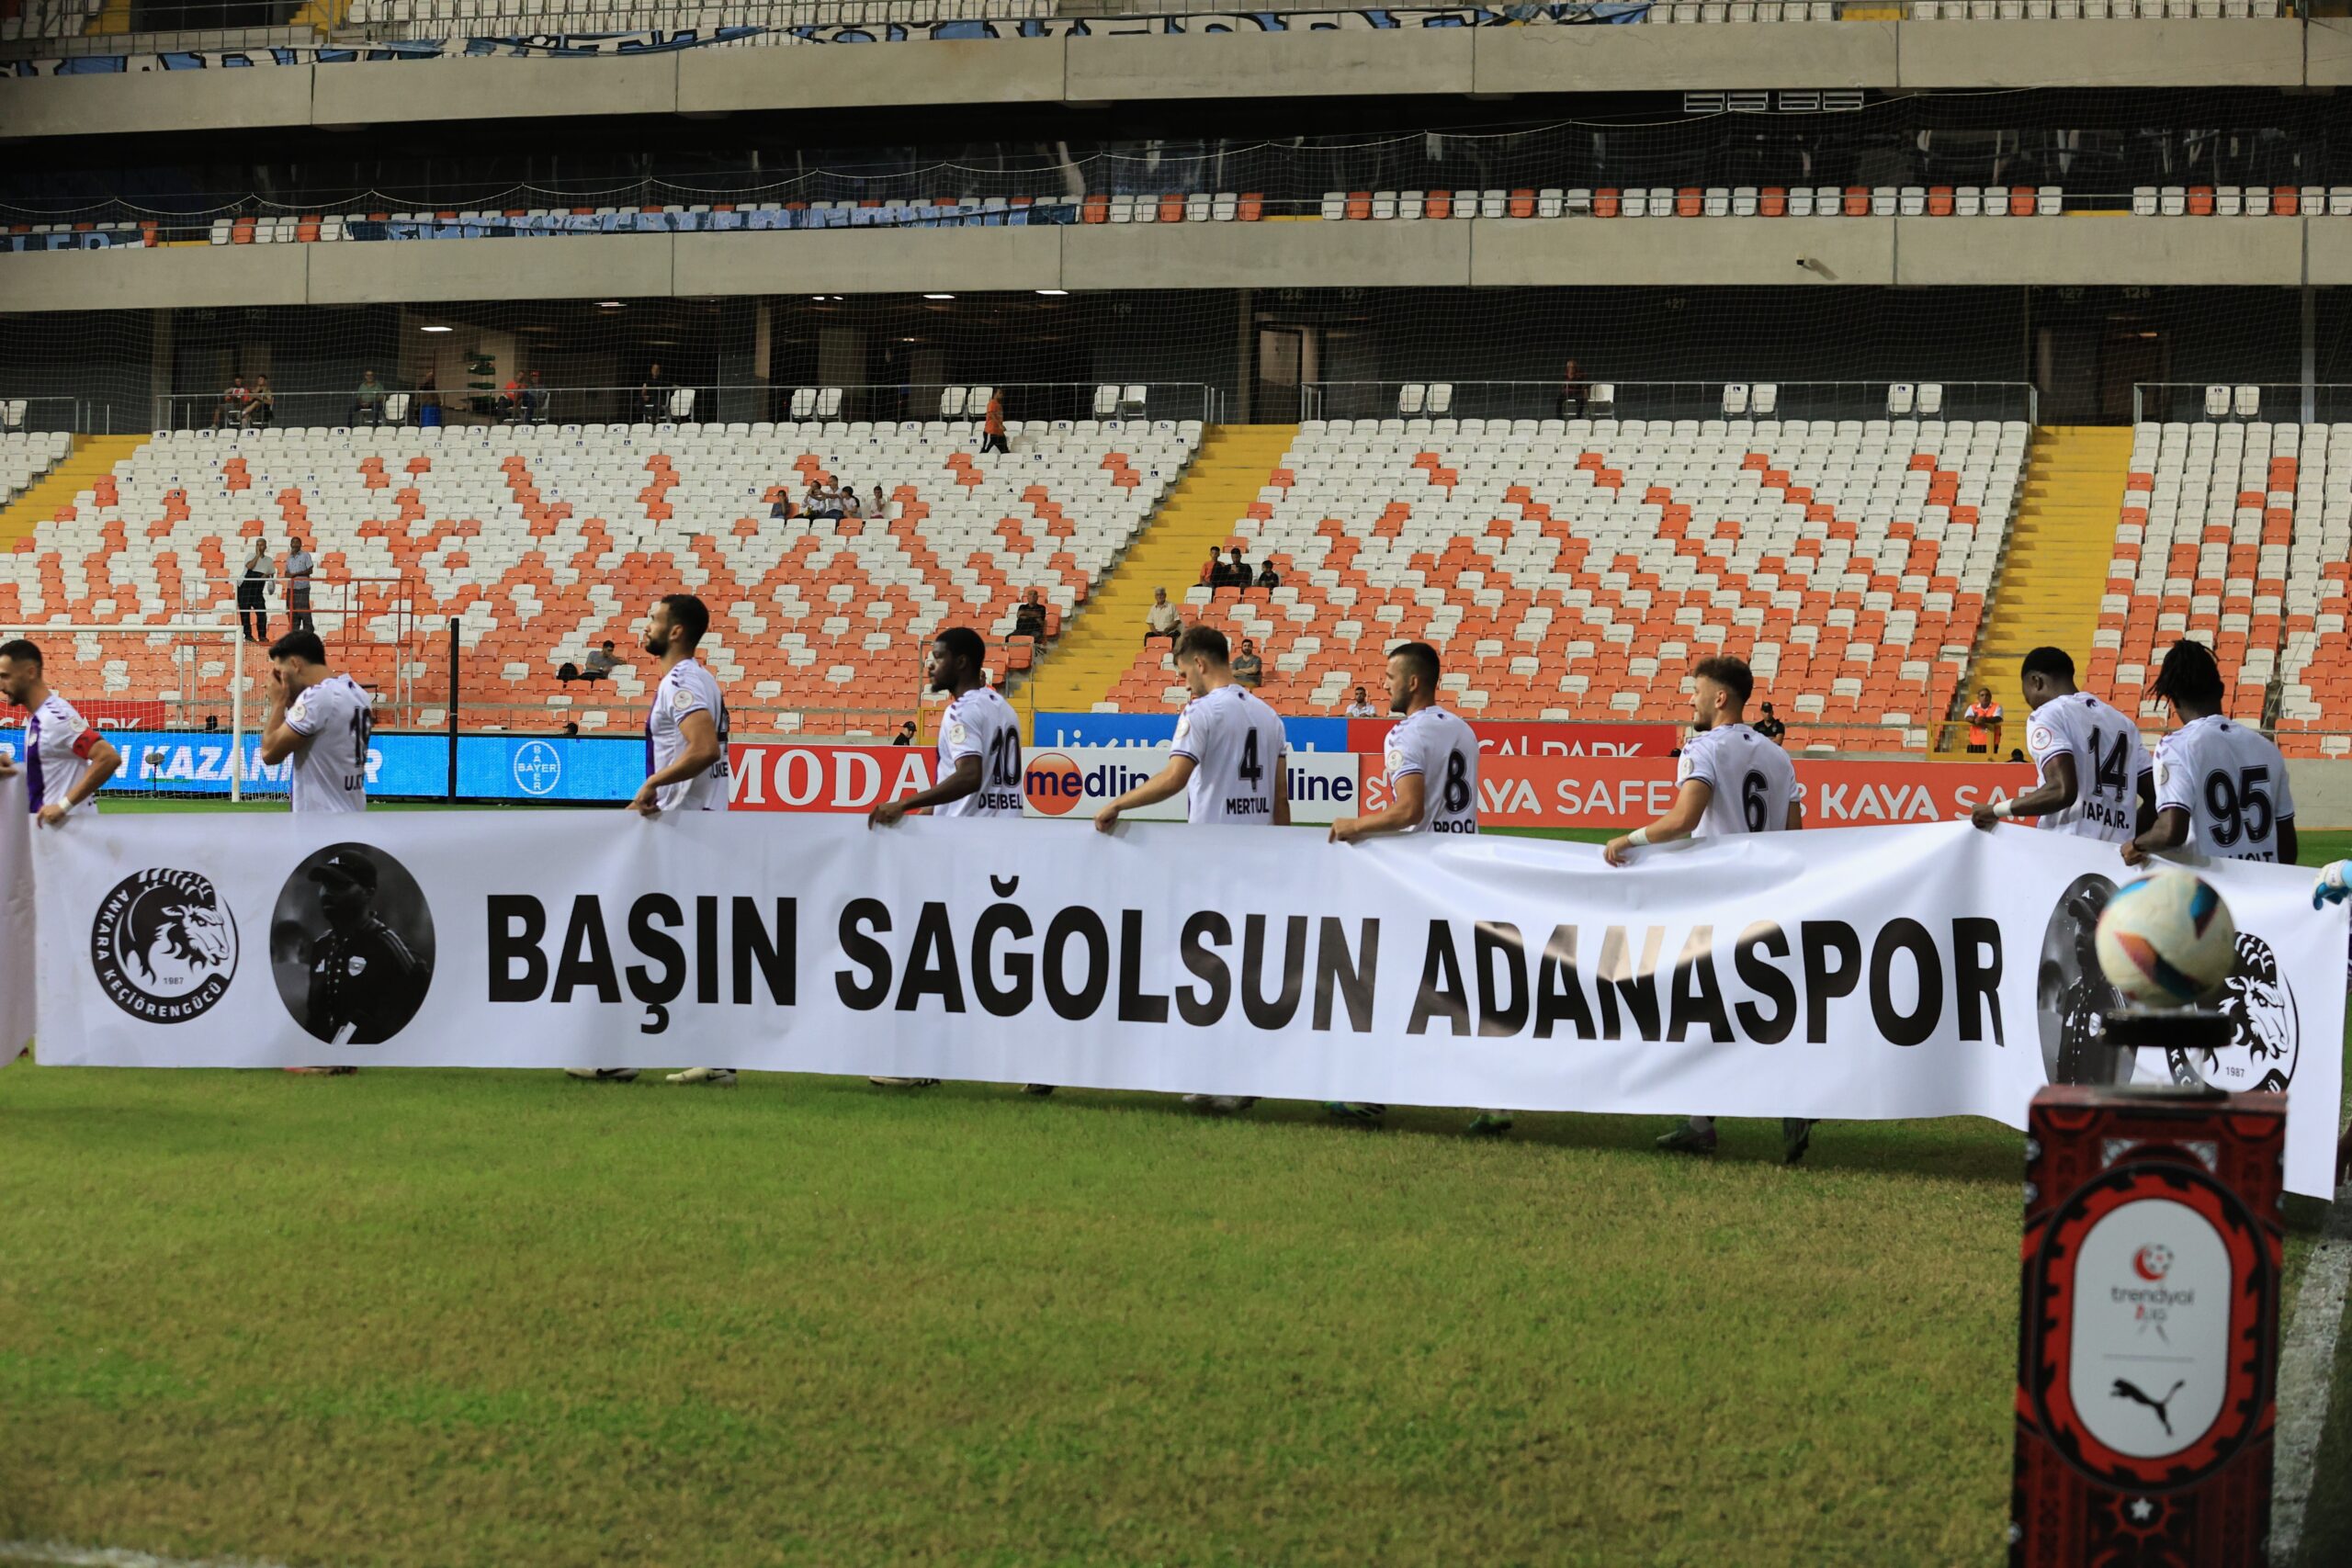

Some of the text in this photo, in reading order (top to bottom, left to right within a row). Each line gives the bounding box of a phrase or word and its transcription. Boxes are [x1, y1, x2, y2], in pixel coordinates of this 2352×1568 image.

[517, 763, 557, 773] BAYER
[533, 745, 542, 790] BAYER
[729, 749, 933, 806] MODA
[989, 725, 1022, 788] 10
[1238, 727, 1263, 793] 4
[1444, 748, 1472, 814] 8
[2087, 725, 2128, 802] 14
[1557, 779, 1673, 815] SAFE
[1742, 769, 1769, 832] 6
[1821, 784, 1939, 821] KAYA
[2204, 764, 2272, 847] 95
[96, 889, 222, 1018] ANKARA KEÇİÖRENGÜCÜ
[164, 976, 184, 985] 1987
[487, 874, 2005, 1048] BAŞIN SAĞOLSUN ADANASPOR
[2225, 1066, 2245, 1077] 1987
